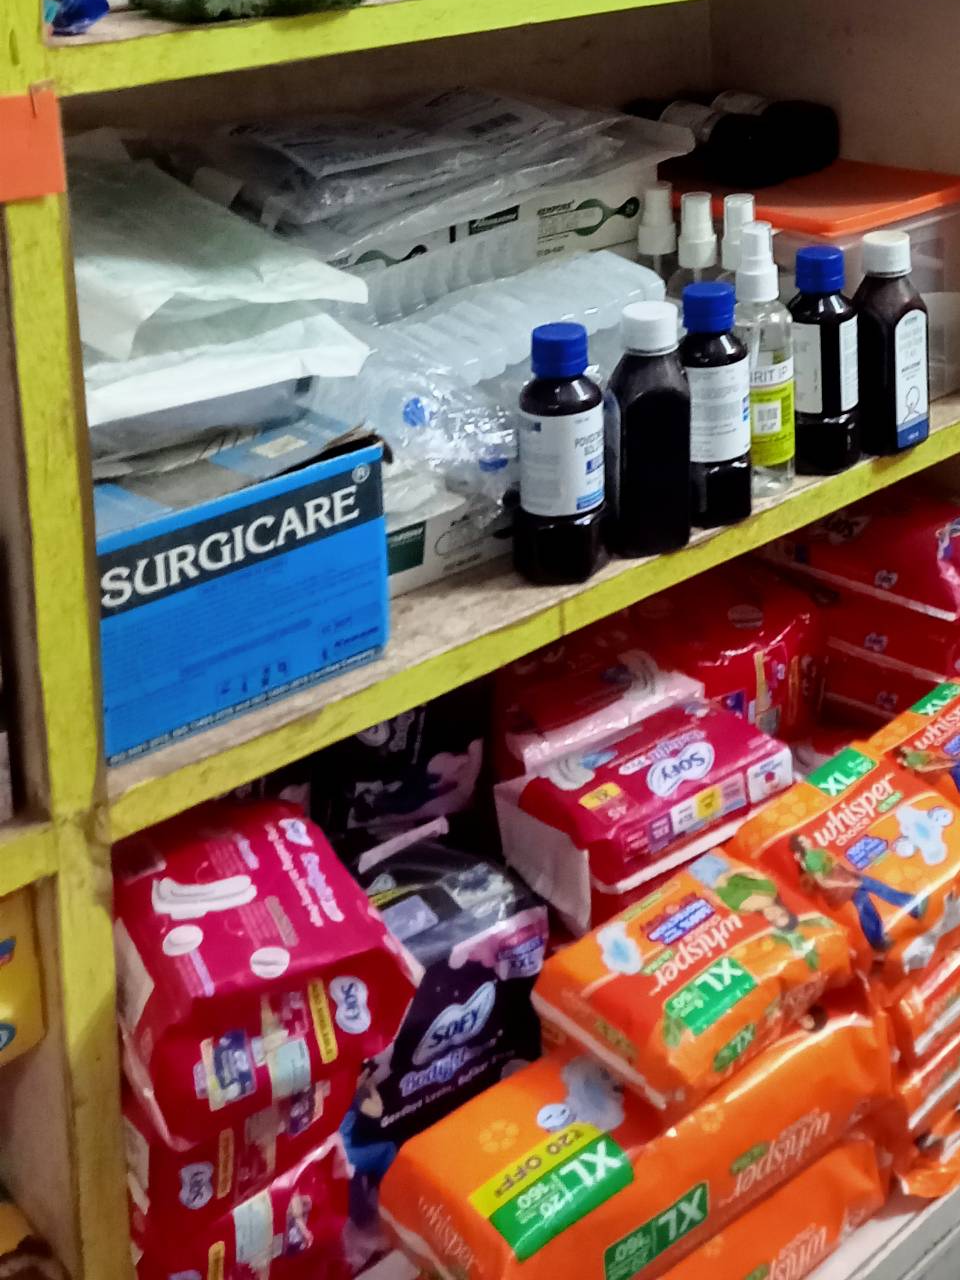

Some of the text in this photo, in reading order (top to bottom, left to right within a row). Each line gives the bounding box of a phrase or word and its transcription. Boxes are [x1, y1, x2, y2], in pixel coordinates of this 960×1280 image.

[100, 485, 360, 609] SURGICARE
[813, 772, 897, 848] whisper
[817, 769, 850, 797] XL
[649, 913, 744, 997] whisper
[694, 957, 745, 993] XL
[559, 1138, 623, 1185] XL
[719, 1108, 832, 1207] whisper
[660, 1189, 703, 1232] XL
